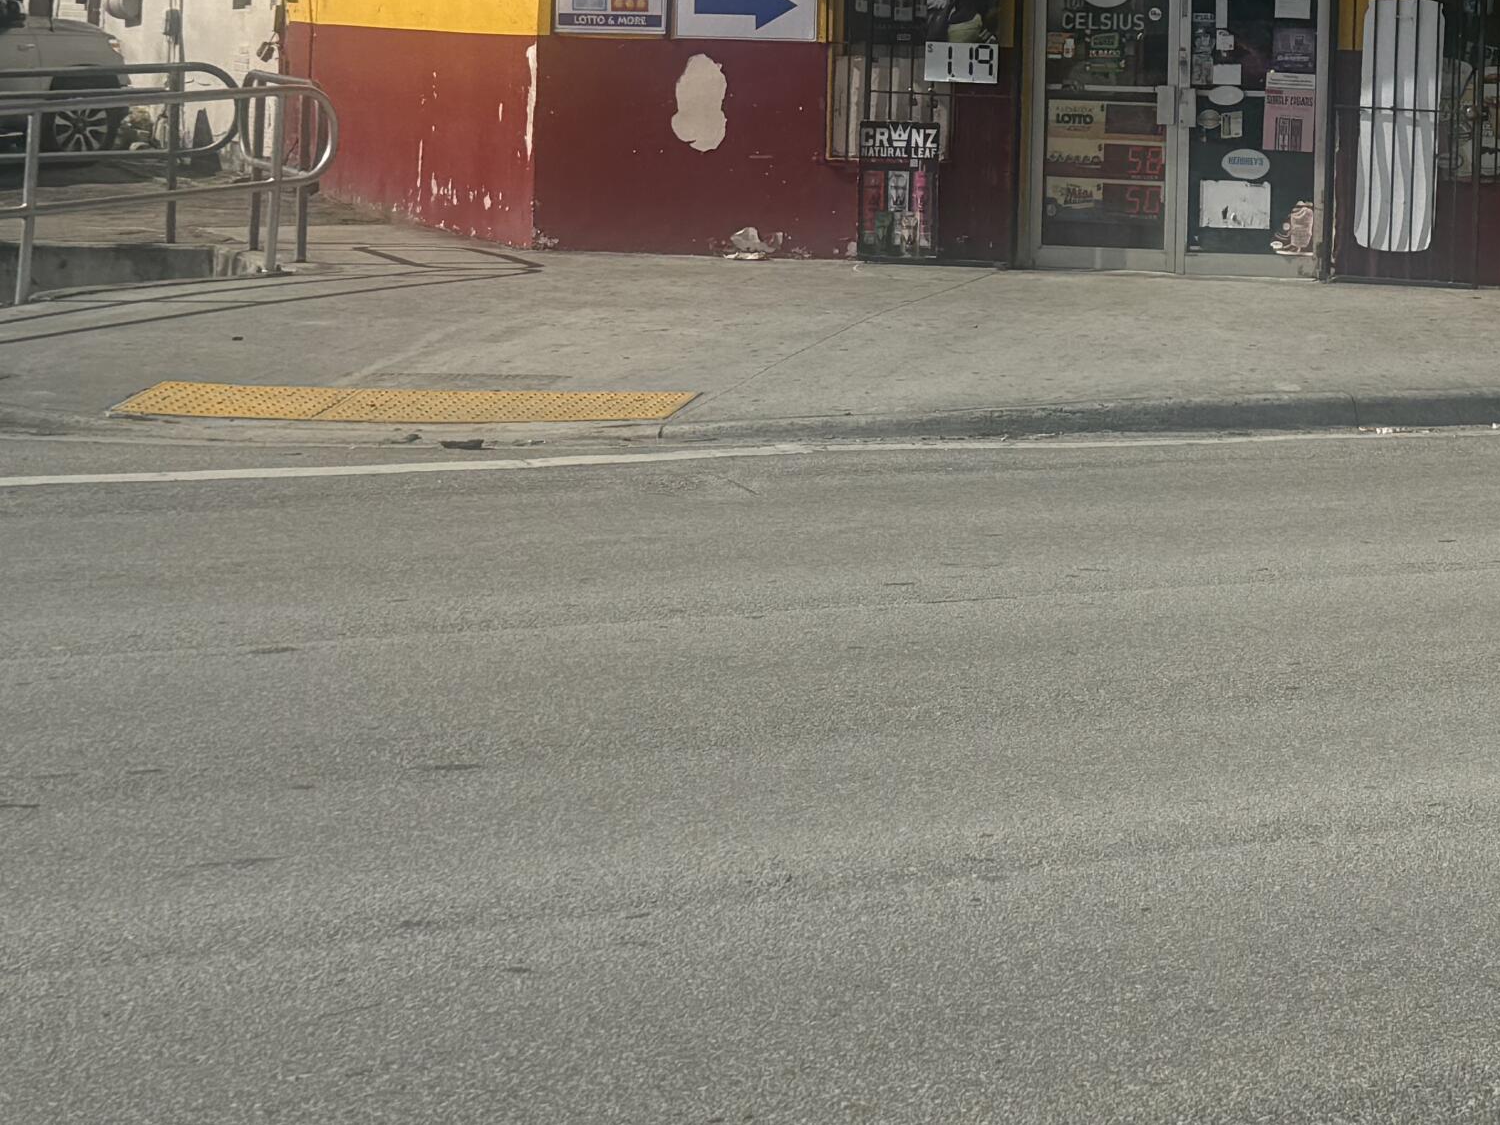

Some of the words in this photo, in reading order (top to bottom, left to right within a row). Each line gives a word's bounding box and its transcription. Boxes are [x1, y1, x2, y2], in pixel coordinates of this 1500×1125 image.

[574, 15, 605, 25] LOTTO
[608, 16, 615, 24] &
[617, 16, 646, 26] MORE
[1062, 12, 1145, 31] CELSIUS
[948, 44, 994, 78] 1.19
[1056, 114, 1094, 125] LOTTO
[861, 147, 908, 158] NATURAL
[911, 147, 937, 159] LEAF
